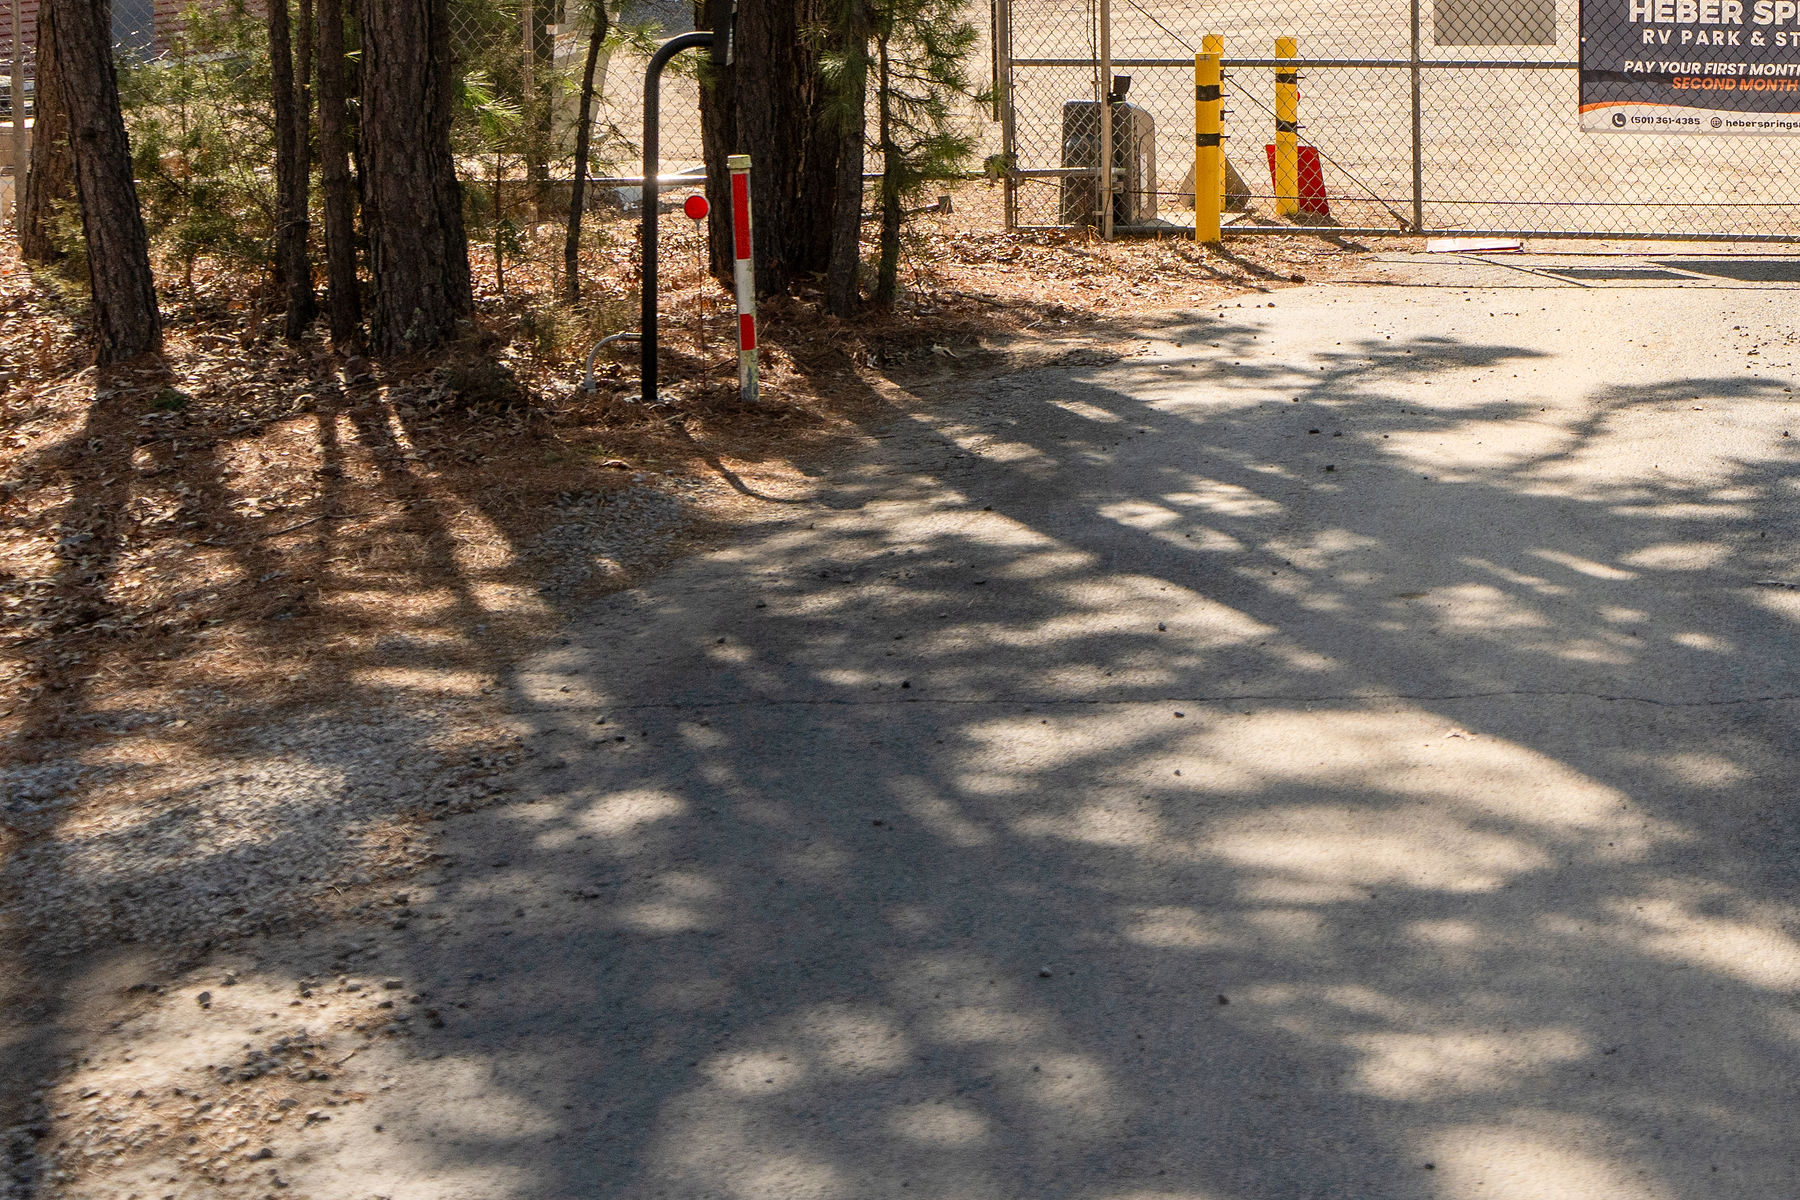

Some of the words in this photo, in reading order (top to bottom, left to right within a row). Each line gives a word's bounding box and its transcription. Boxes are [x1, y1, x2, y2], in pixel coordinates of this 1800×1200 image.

[1643, 29, 1672, 45] RV
[1681, 30, 1741, 46] PARK
[1750, 31, 1766, 46] &
[1623, 60, 1656, 73] PAY
[1658, 61, 1702, 74] YOUR
[1704, 62, 1748, 75] FIRST
[1672, 77, 1737, 91] SECOND
[1738, 78, 1798, 92] MONTH
[1631, 116, 1654, 125] (501)
[1656, 116, 1701, 125] 361-4385
